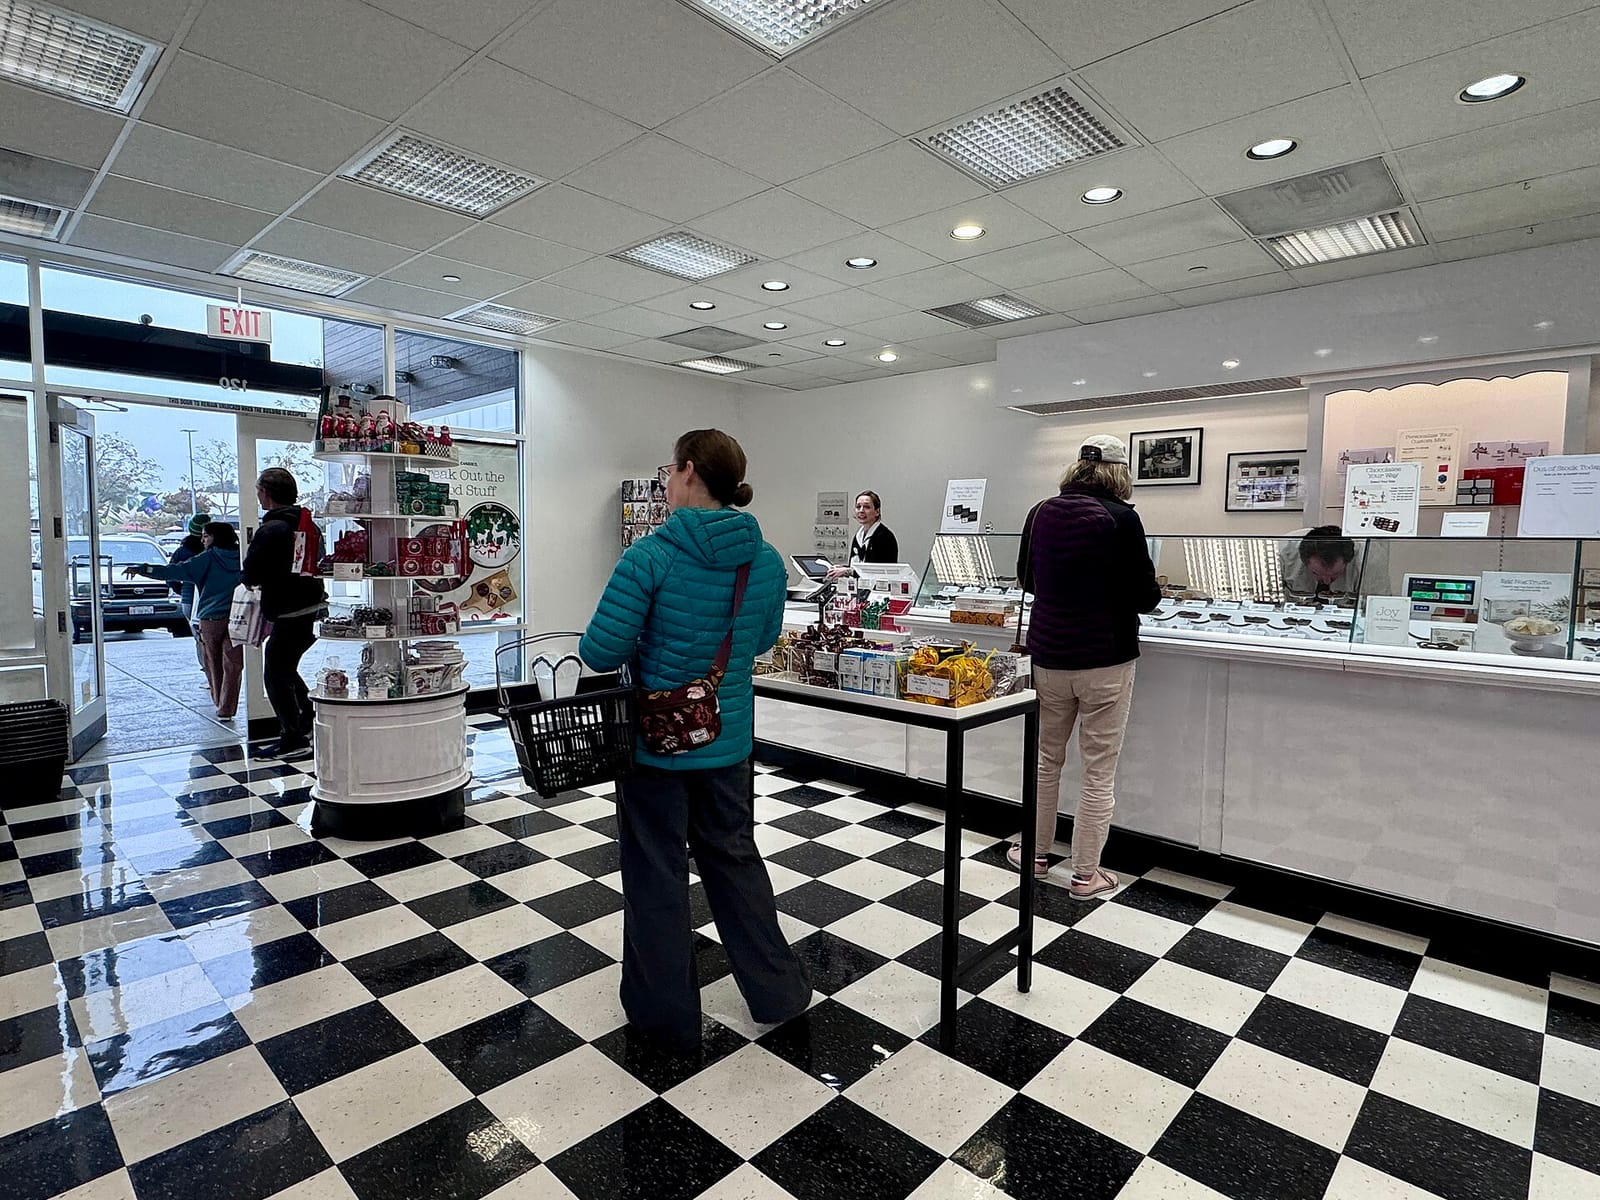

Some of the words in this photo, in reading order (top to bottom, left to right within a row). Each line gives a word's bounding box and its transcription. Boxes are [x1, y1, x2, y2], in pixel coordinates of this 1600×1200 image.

[219, 307, 261, 337] EXIT
[460, 469, 483, 482] Out
[485, 471, 505, 483] the
[466, 484, 497, 497] Stuff
[1375, 606, 1400, 619] Joy
